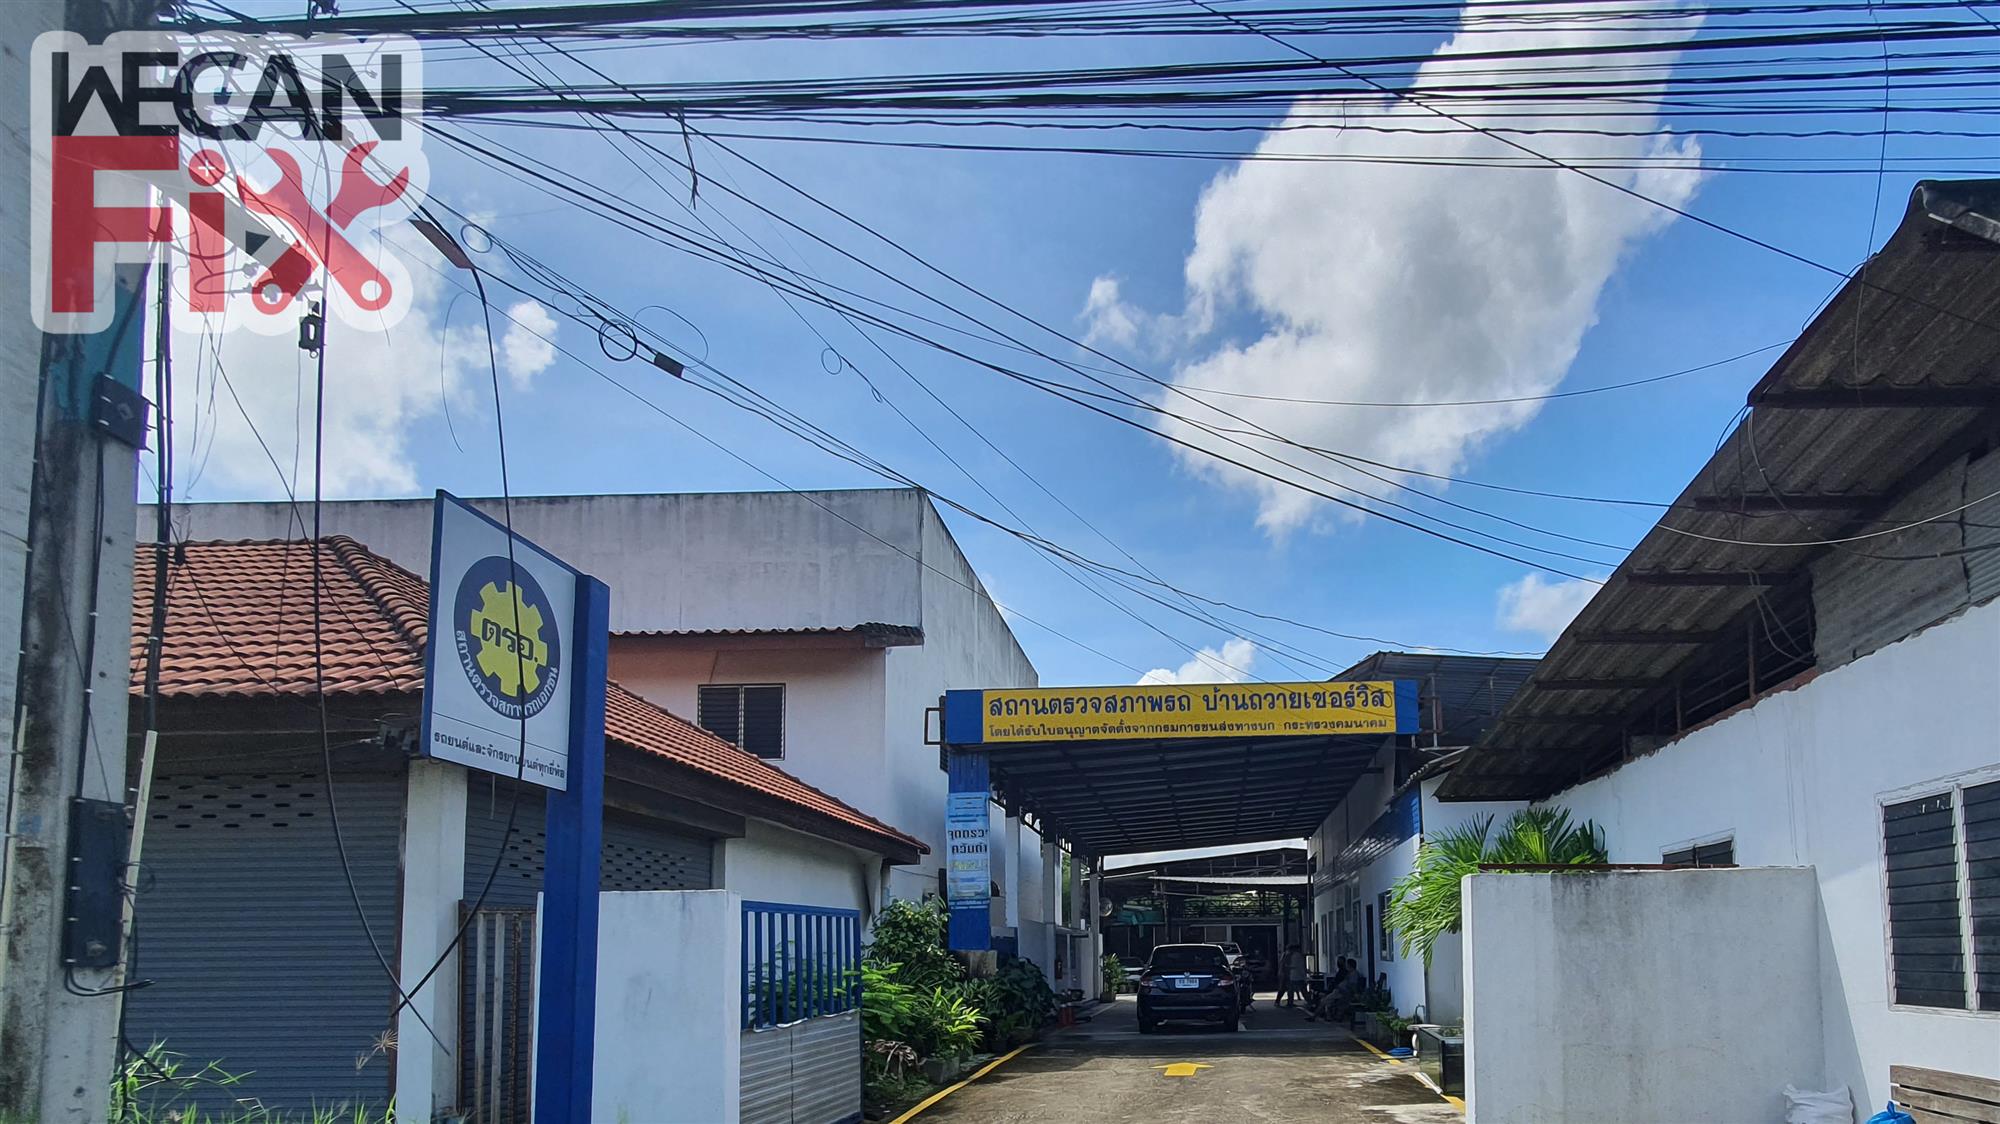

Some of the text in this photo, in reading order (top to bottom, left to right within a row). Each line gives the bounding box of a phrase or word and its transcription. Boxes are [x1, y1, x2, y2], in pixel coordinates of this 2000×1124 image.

[988, 693, 1192, 717] สถานตรวจสภาพรถ
